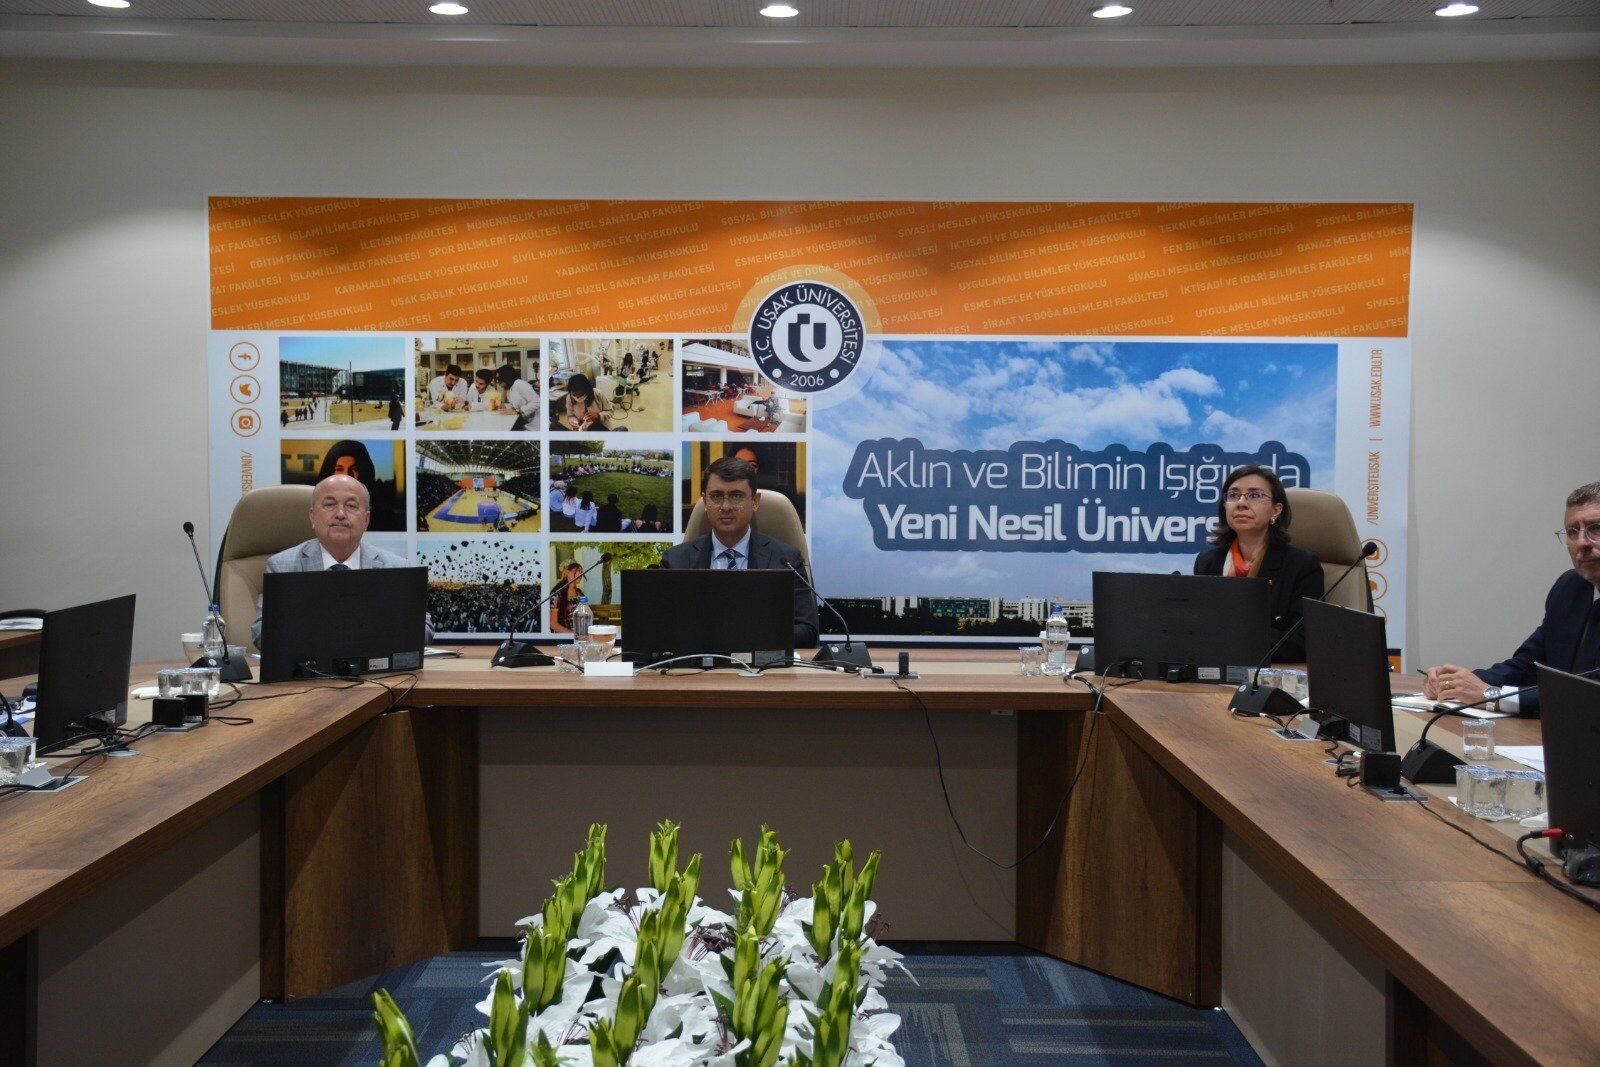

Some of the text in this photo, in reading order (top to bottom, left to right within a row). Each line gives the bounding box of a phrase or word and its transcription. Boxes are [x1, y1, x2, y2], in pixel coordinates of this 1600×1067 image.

[756, 285, 862, 366] T.C. UŞAK ÜNİVERSİTESİ
[790, 374, 824, 387] 2006
[857, 452, 951, 489] Aklın
[963, 463, 1009, 489] ve
[1021, 453, 1146, 490] Bilimin
[878, 498, 1220, 543] Yeni Nesil Ünivers
